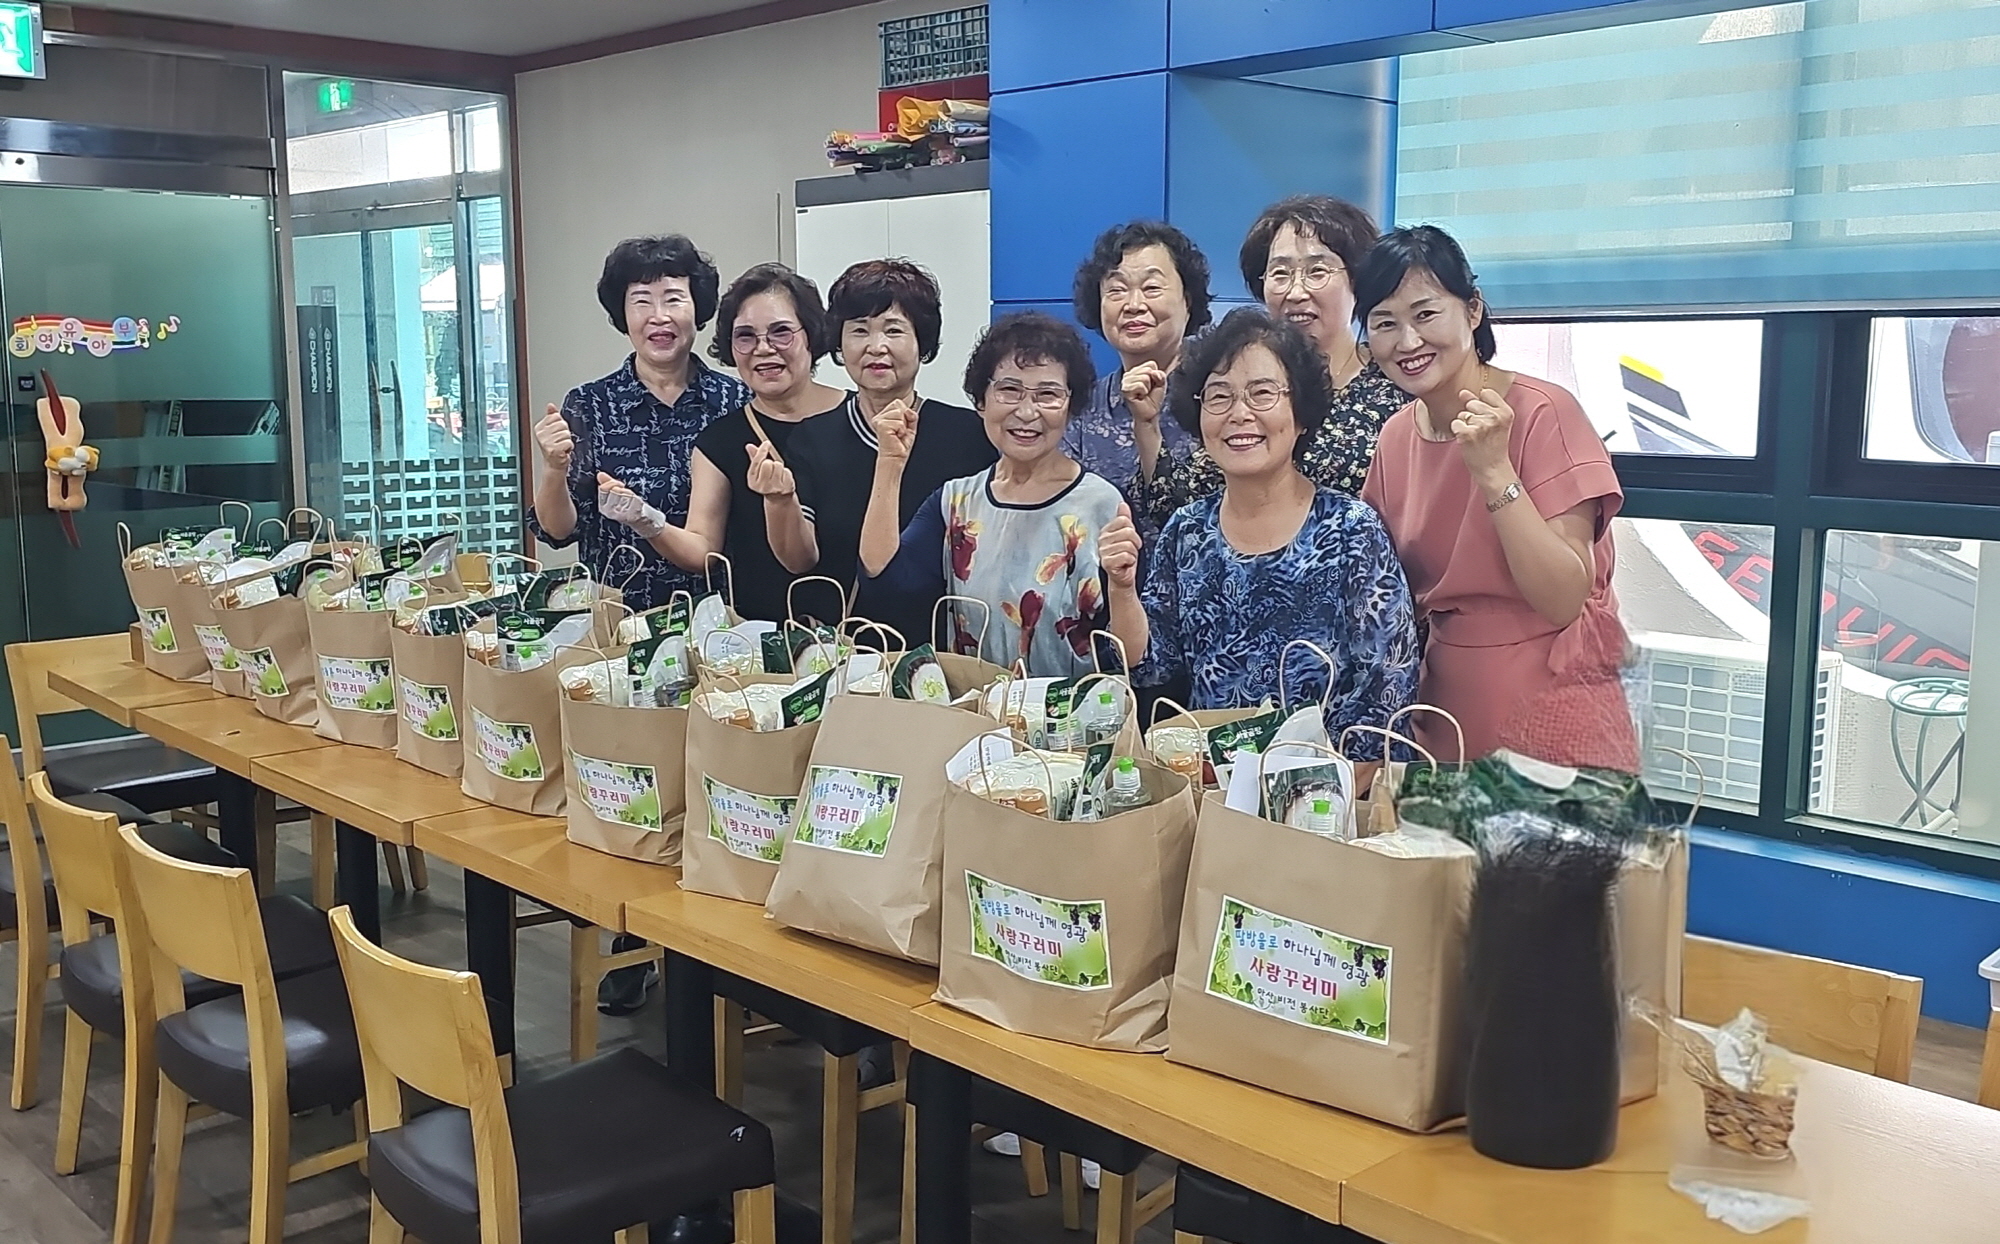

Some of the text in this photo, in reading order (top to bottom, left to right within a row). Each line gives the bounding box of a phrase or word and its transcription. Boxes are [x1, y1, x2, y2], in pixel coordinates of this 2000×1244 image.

[310, 341, 318, 393] CHAMPION
[325, 341, 333, 393] CHAMPION
[589, 785, 631, 806] 랑꾸러미
[995, 922, 1062, 958] 사랑꾸러미
[1014, 906, 1057, 929] 하나님께
[1061, 922, 1088, 943] 영광
[1250, 956, 1338, 1001] 사랑꾸러미
[1283, 938, 1337, 968] 하나님께
[1341, 961, 1370, 988] 영광
[1299, 1001, 1329, 1019] 봉사단
